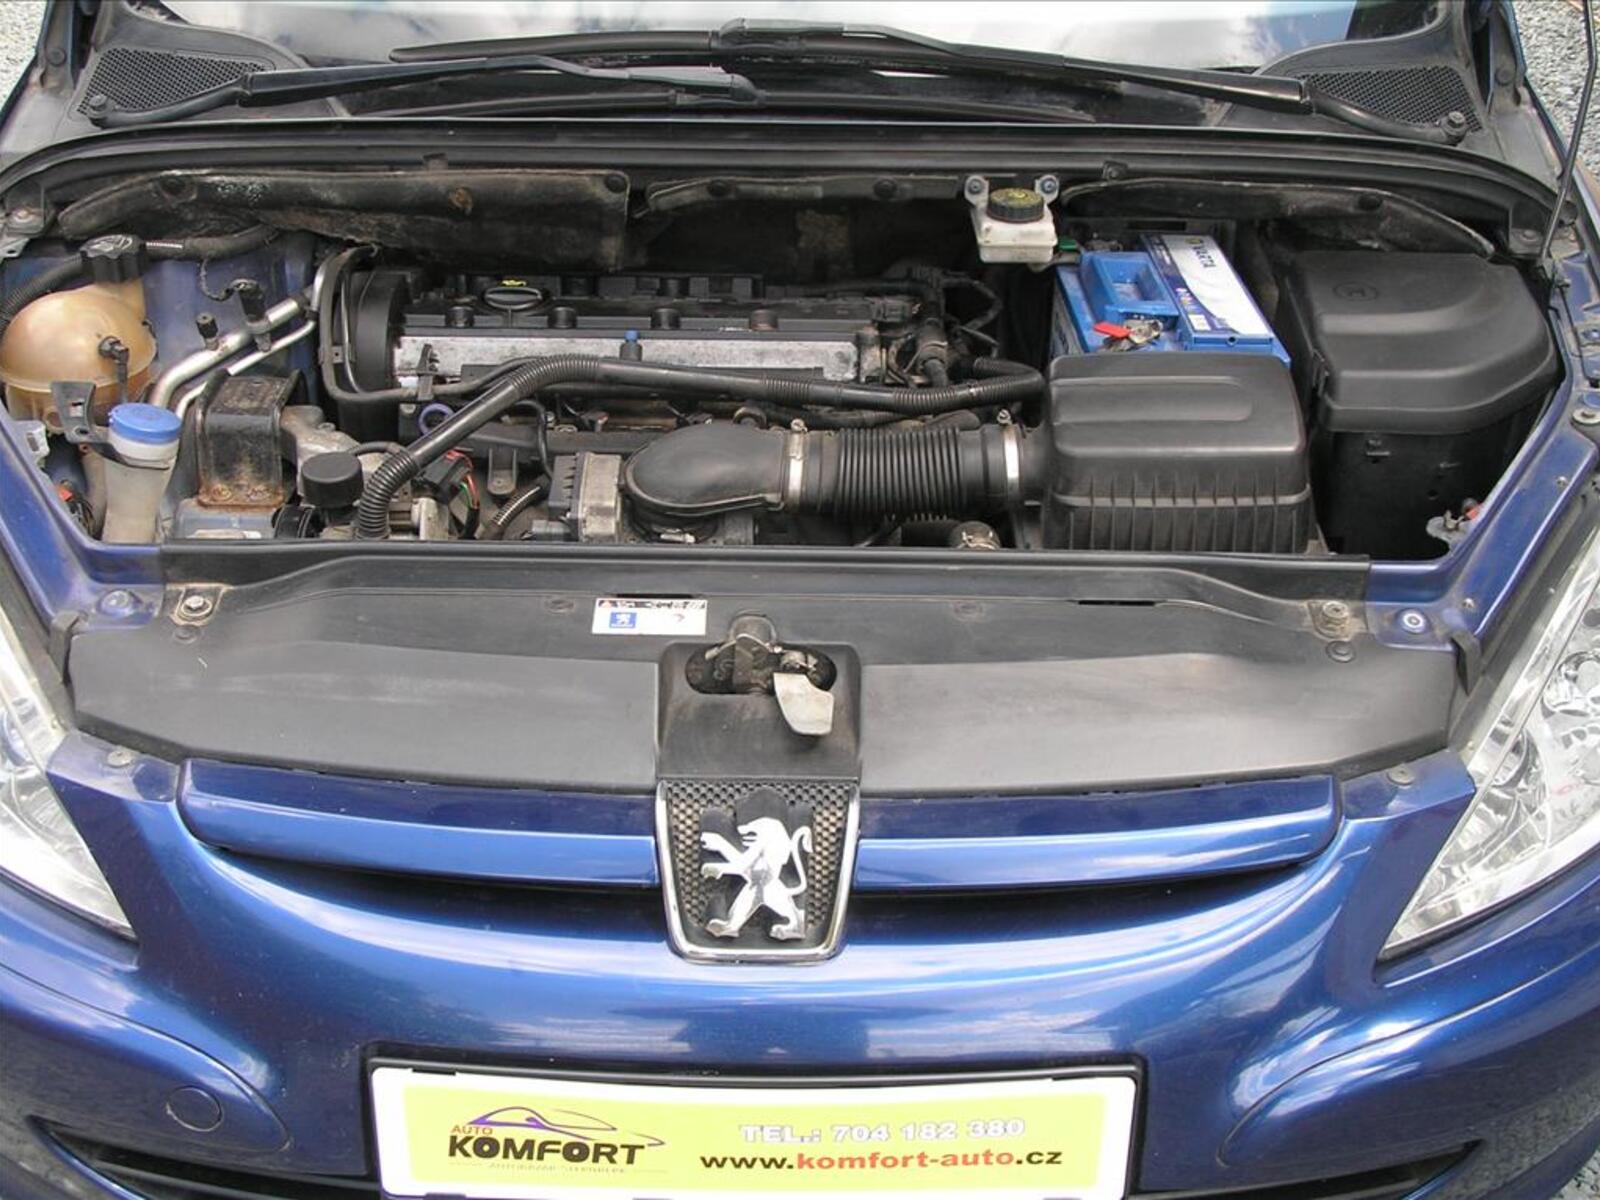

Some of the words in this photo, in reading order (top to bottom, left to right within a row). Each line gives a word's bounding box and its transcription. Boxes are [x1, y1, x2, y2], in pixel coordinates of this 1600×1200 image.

[451, 1124, 493, 1136] AUTO
[830, 1123, 890, 1142] 704
[900, 1121, 958, 1140] 182
[966, 1117, 1026, 1137] 380
[448, 1134, 645, 1165] KOMFORT
[700, 1149, 1064, 1170] www.komfort-auto.cz
